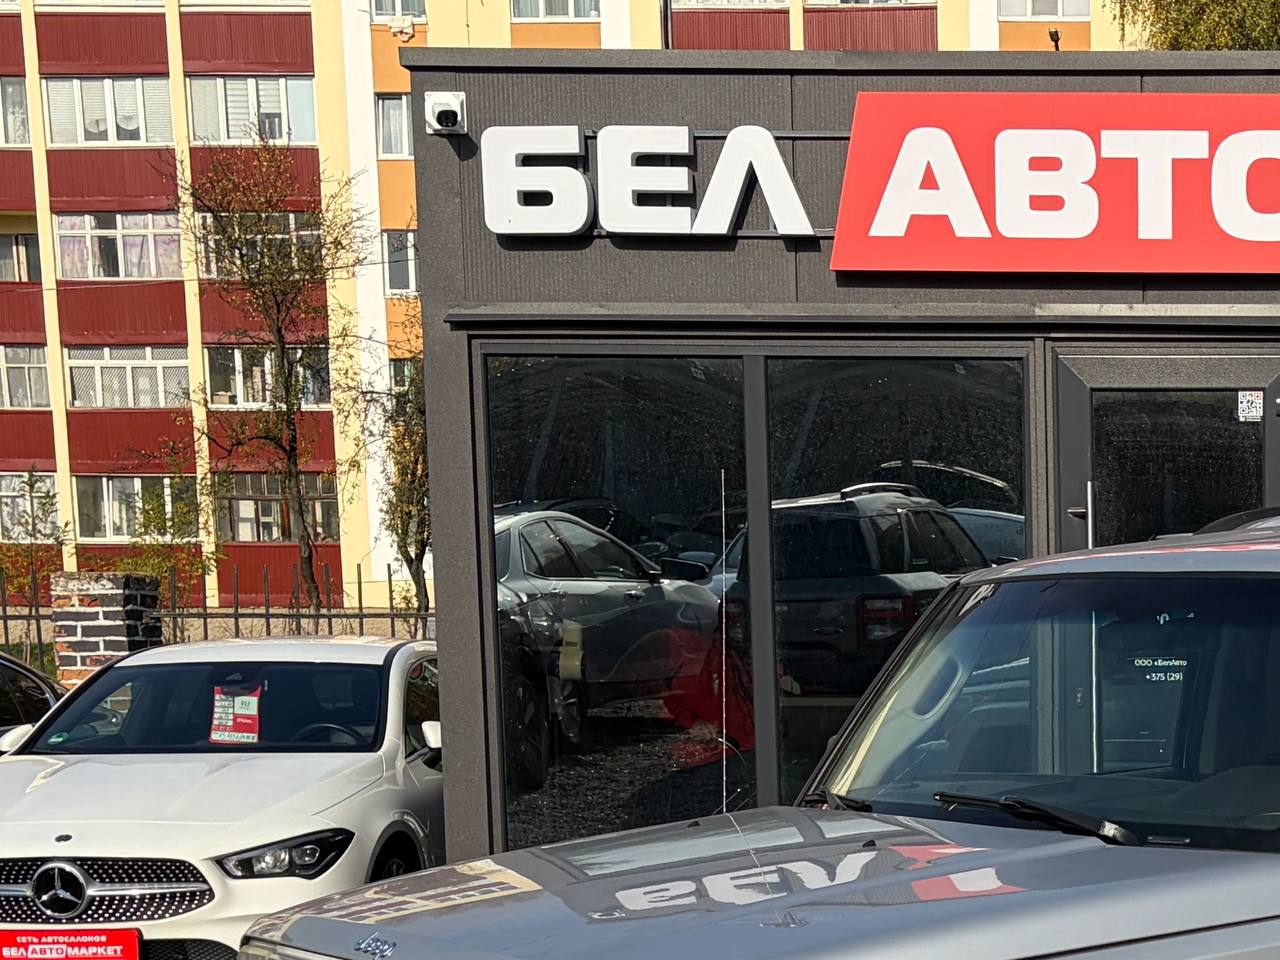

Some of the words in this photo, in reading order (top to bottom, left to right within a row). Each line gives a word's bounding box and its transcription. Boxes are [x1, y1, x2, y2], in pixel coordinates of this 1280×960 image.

[480, 124, 816, 238] БЕЛ
[1146, 672, 1165, 681] +375
[1166, 672, 1183, 681] (29)
[16, 935, 39, 943] СЕТЬ
[41, 935, 107, 943] АВТОСАЛОНОВ
[355, 931, 397, 960] Jeep
